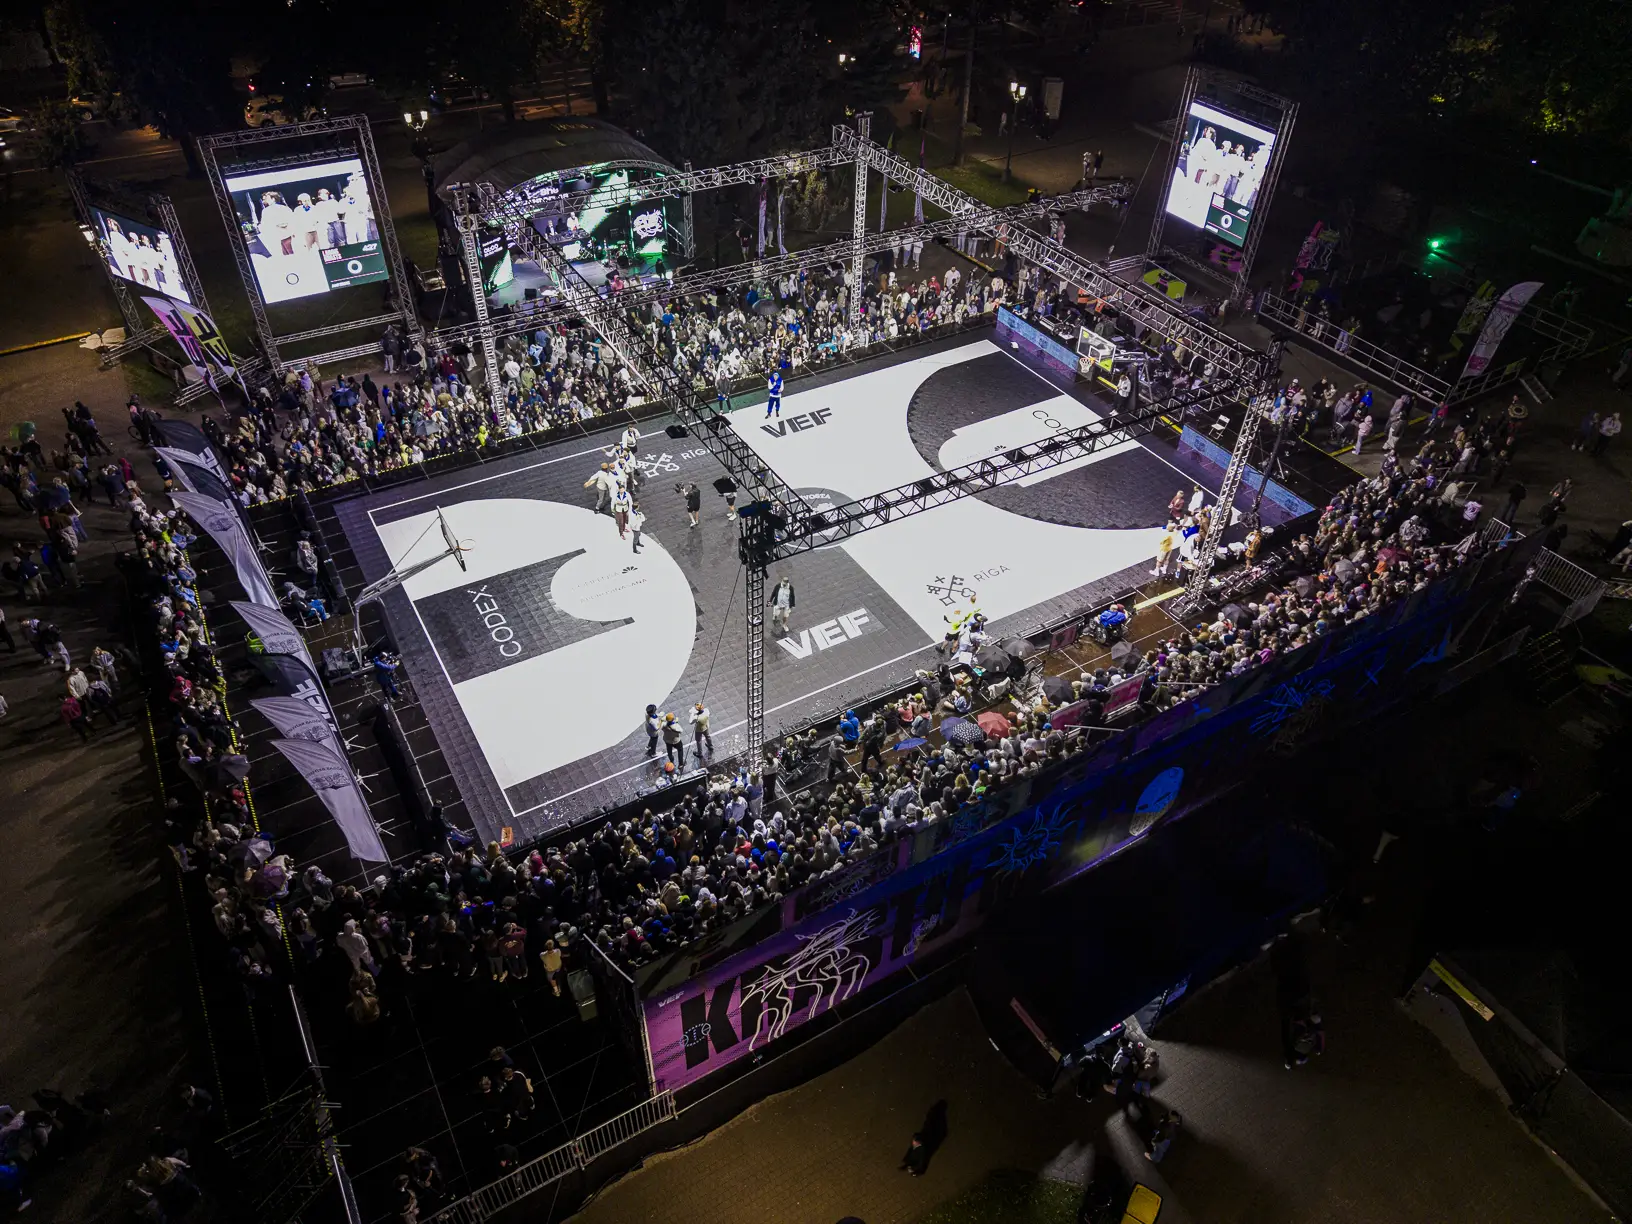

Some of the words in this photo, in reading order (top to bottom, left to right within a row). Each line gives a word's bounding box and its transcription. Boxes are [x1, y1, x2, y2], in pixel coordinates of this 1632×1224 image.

[347, 259, 363, 274] 0
[760, 407, 833, 437] VEF
[973, 564, 1011, 582] RĪGA
[467, 584, 522, 657] CODEX
[776, 608, 870, 660] VEF
